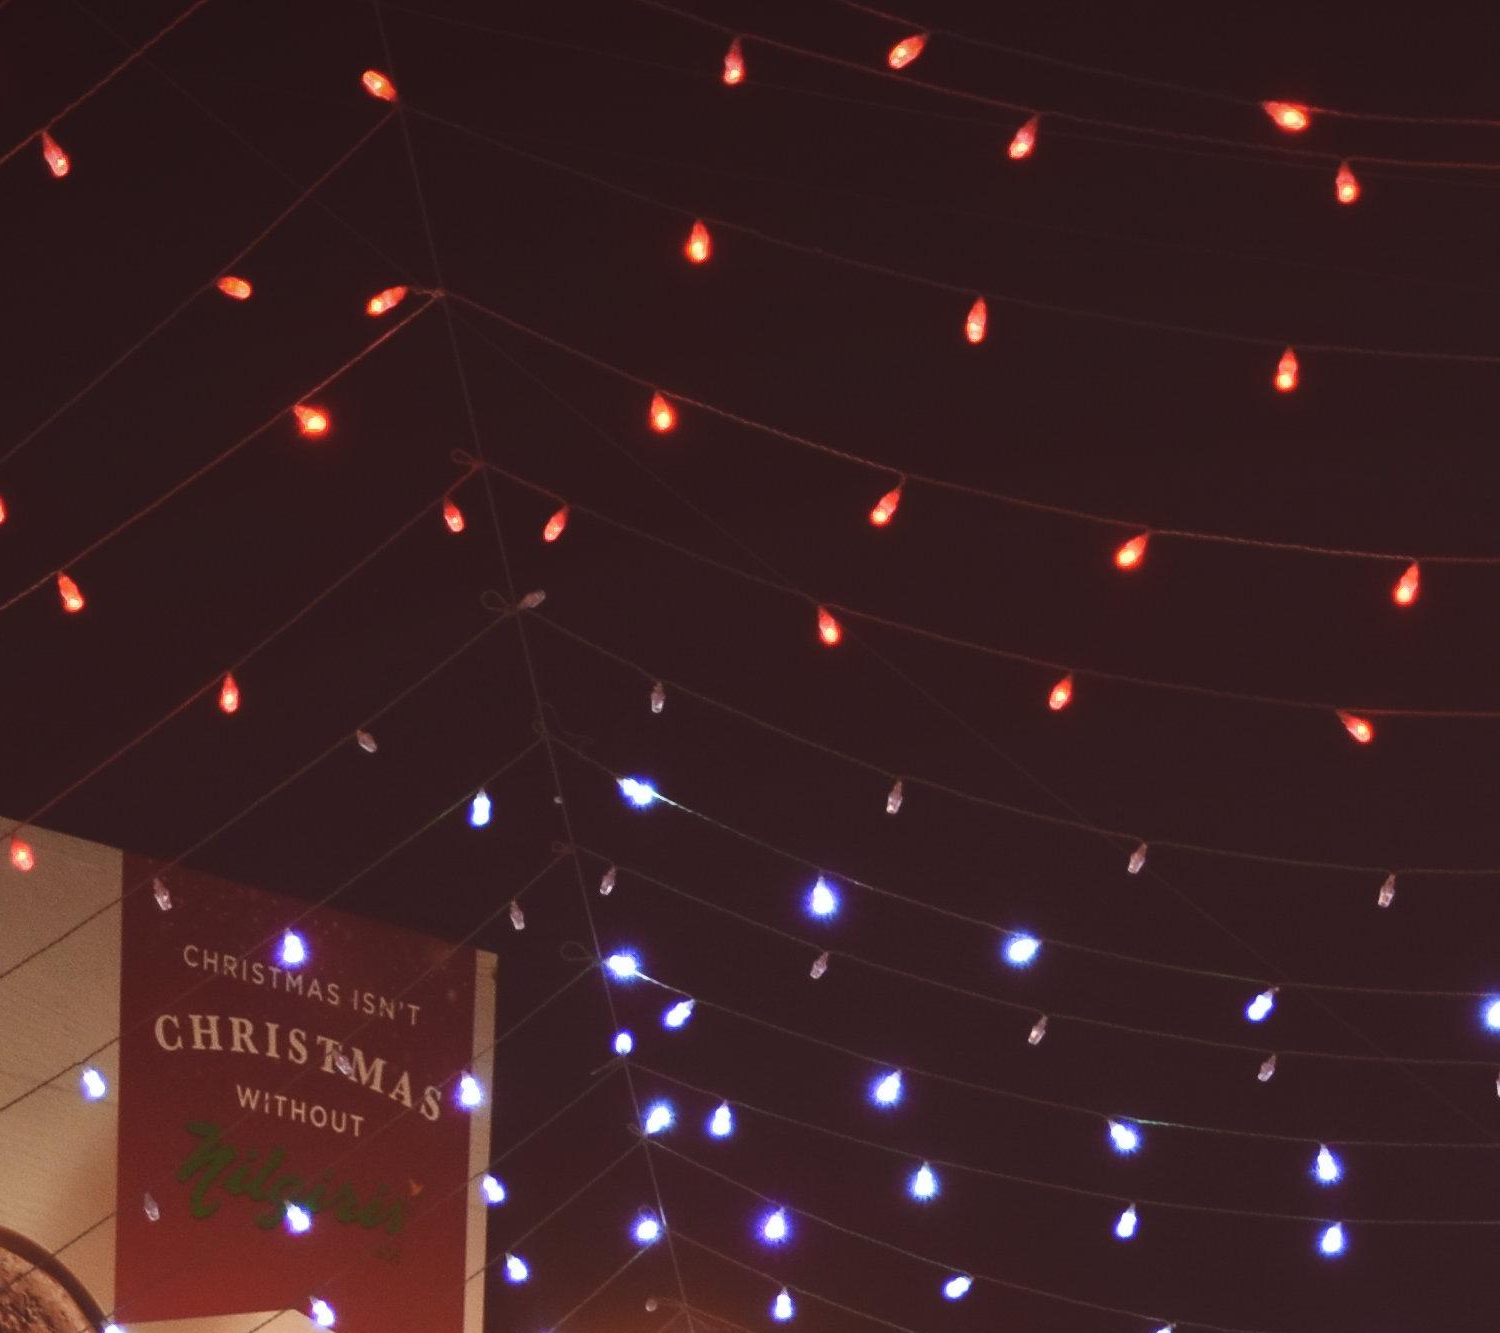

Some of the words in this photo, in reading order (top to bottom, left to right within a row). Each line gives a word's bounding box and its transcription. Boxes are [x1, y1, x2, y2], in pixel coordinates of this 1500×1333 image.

[184, 944, 340, 1005] CHRISTMAS
[353, 990, 421, 1026] ISN'T
[154, 1014, 441, 1121] CHRISTMAS
[236, 1084, 364, 1137] WITHOUT
